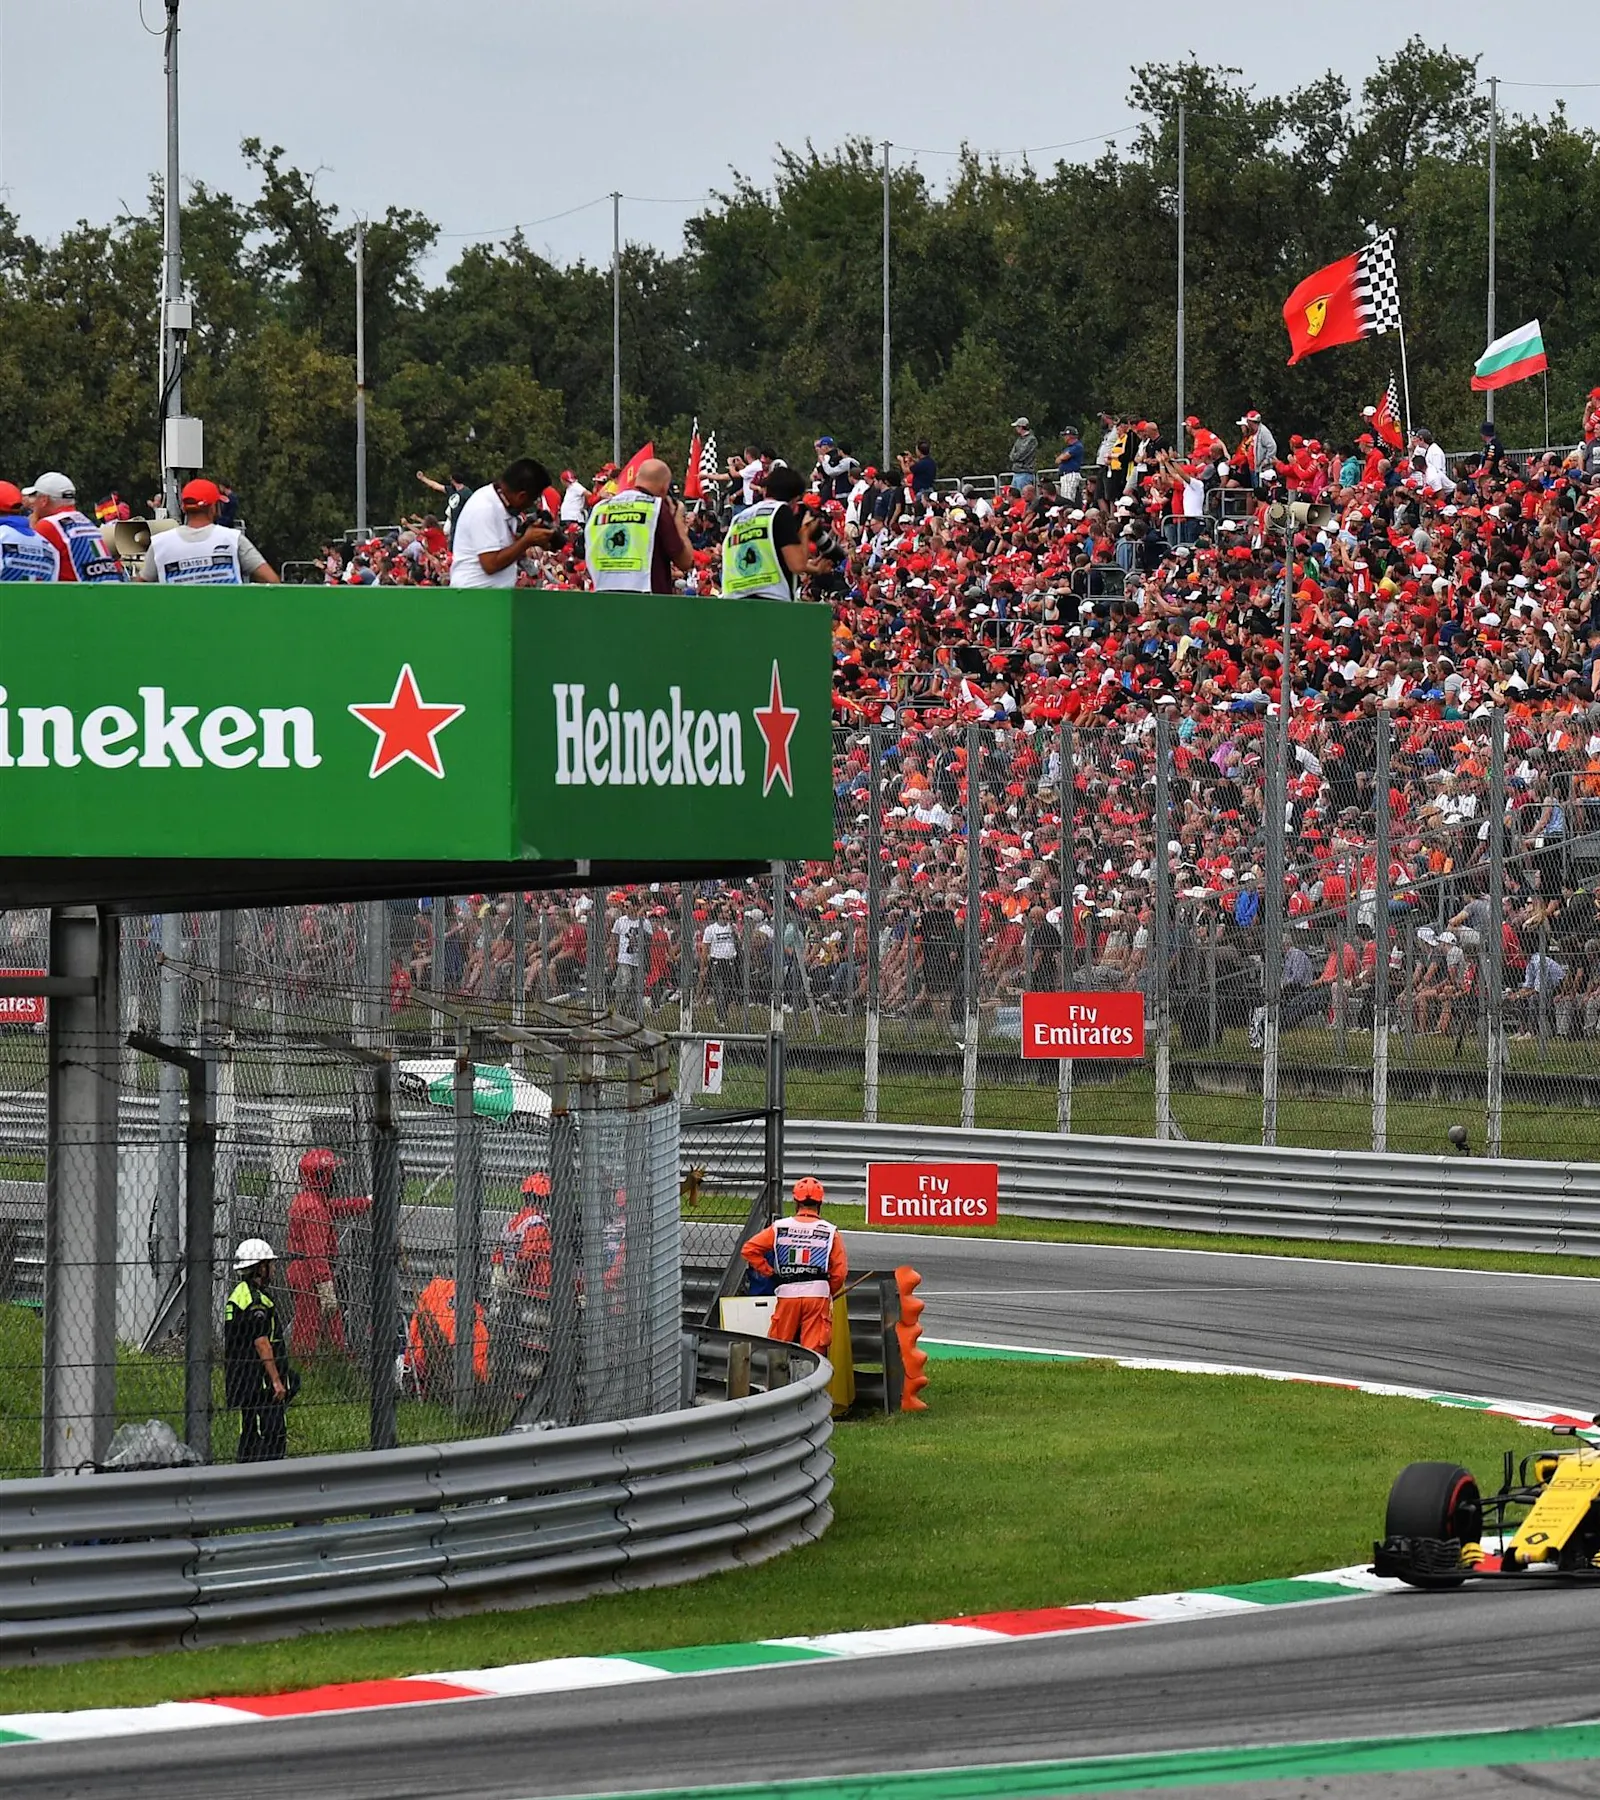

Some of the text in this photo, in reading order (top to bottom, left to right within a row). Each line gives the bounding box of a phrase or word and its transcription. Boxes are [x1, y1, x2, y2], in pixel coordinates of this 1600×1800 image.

[610, 513, 641, 522] PHOTO
[553, 682, 746, 787] Heineken
[1069, 1005, 1097, 1023] Fly
[1034, 1022, 1133, 1045] Emirates
[704, 1042, 721, 1086] F
[918, 1175, 949, 1195] Fly
[880, 1193, 988, 1217] Emirates
[781, 1266, 818, 1275] COURSE
